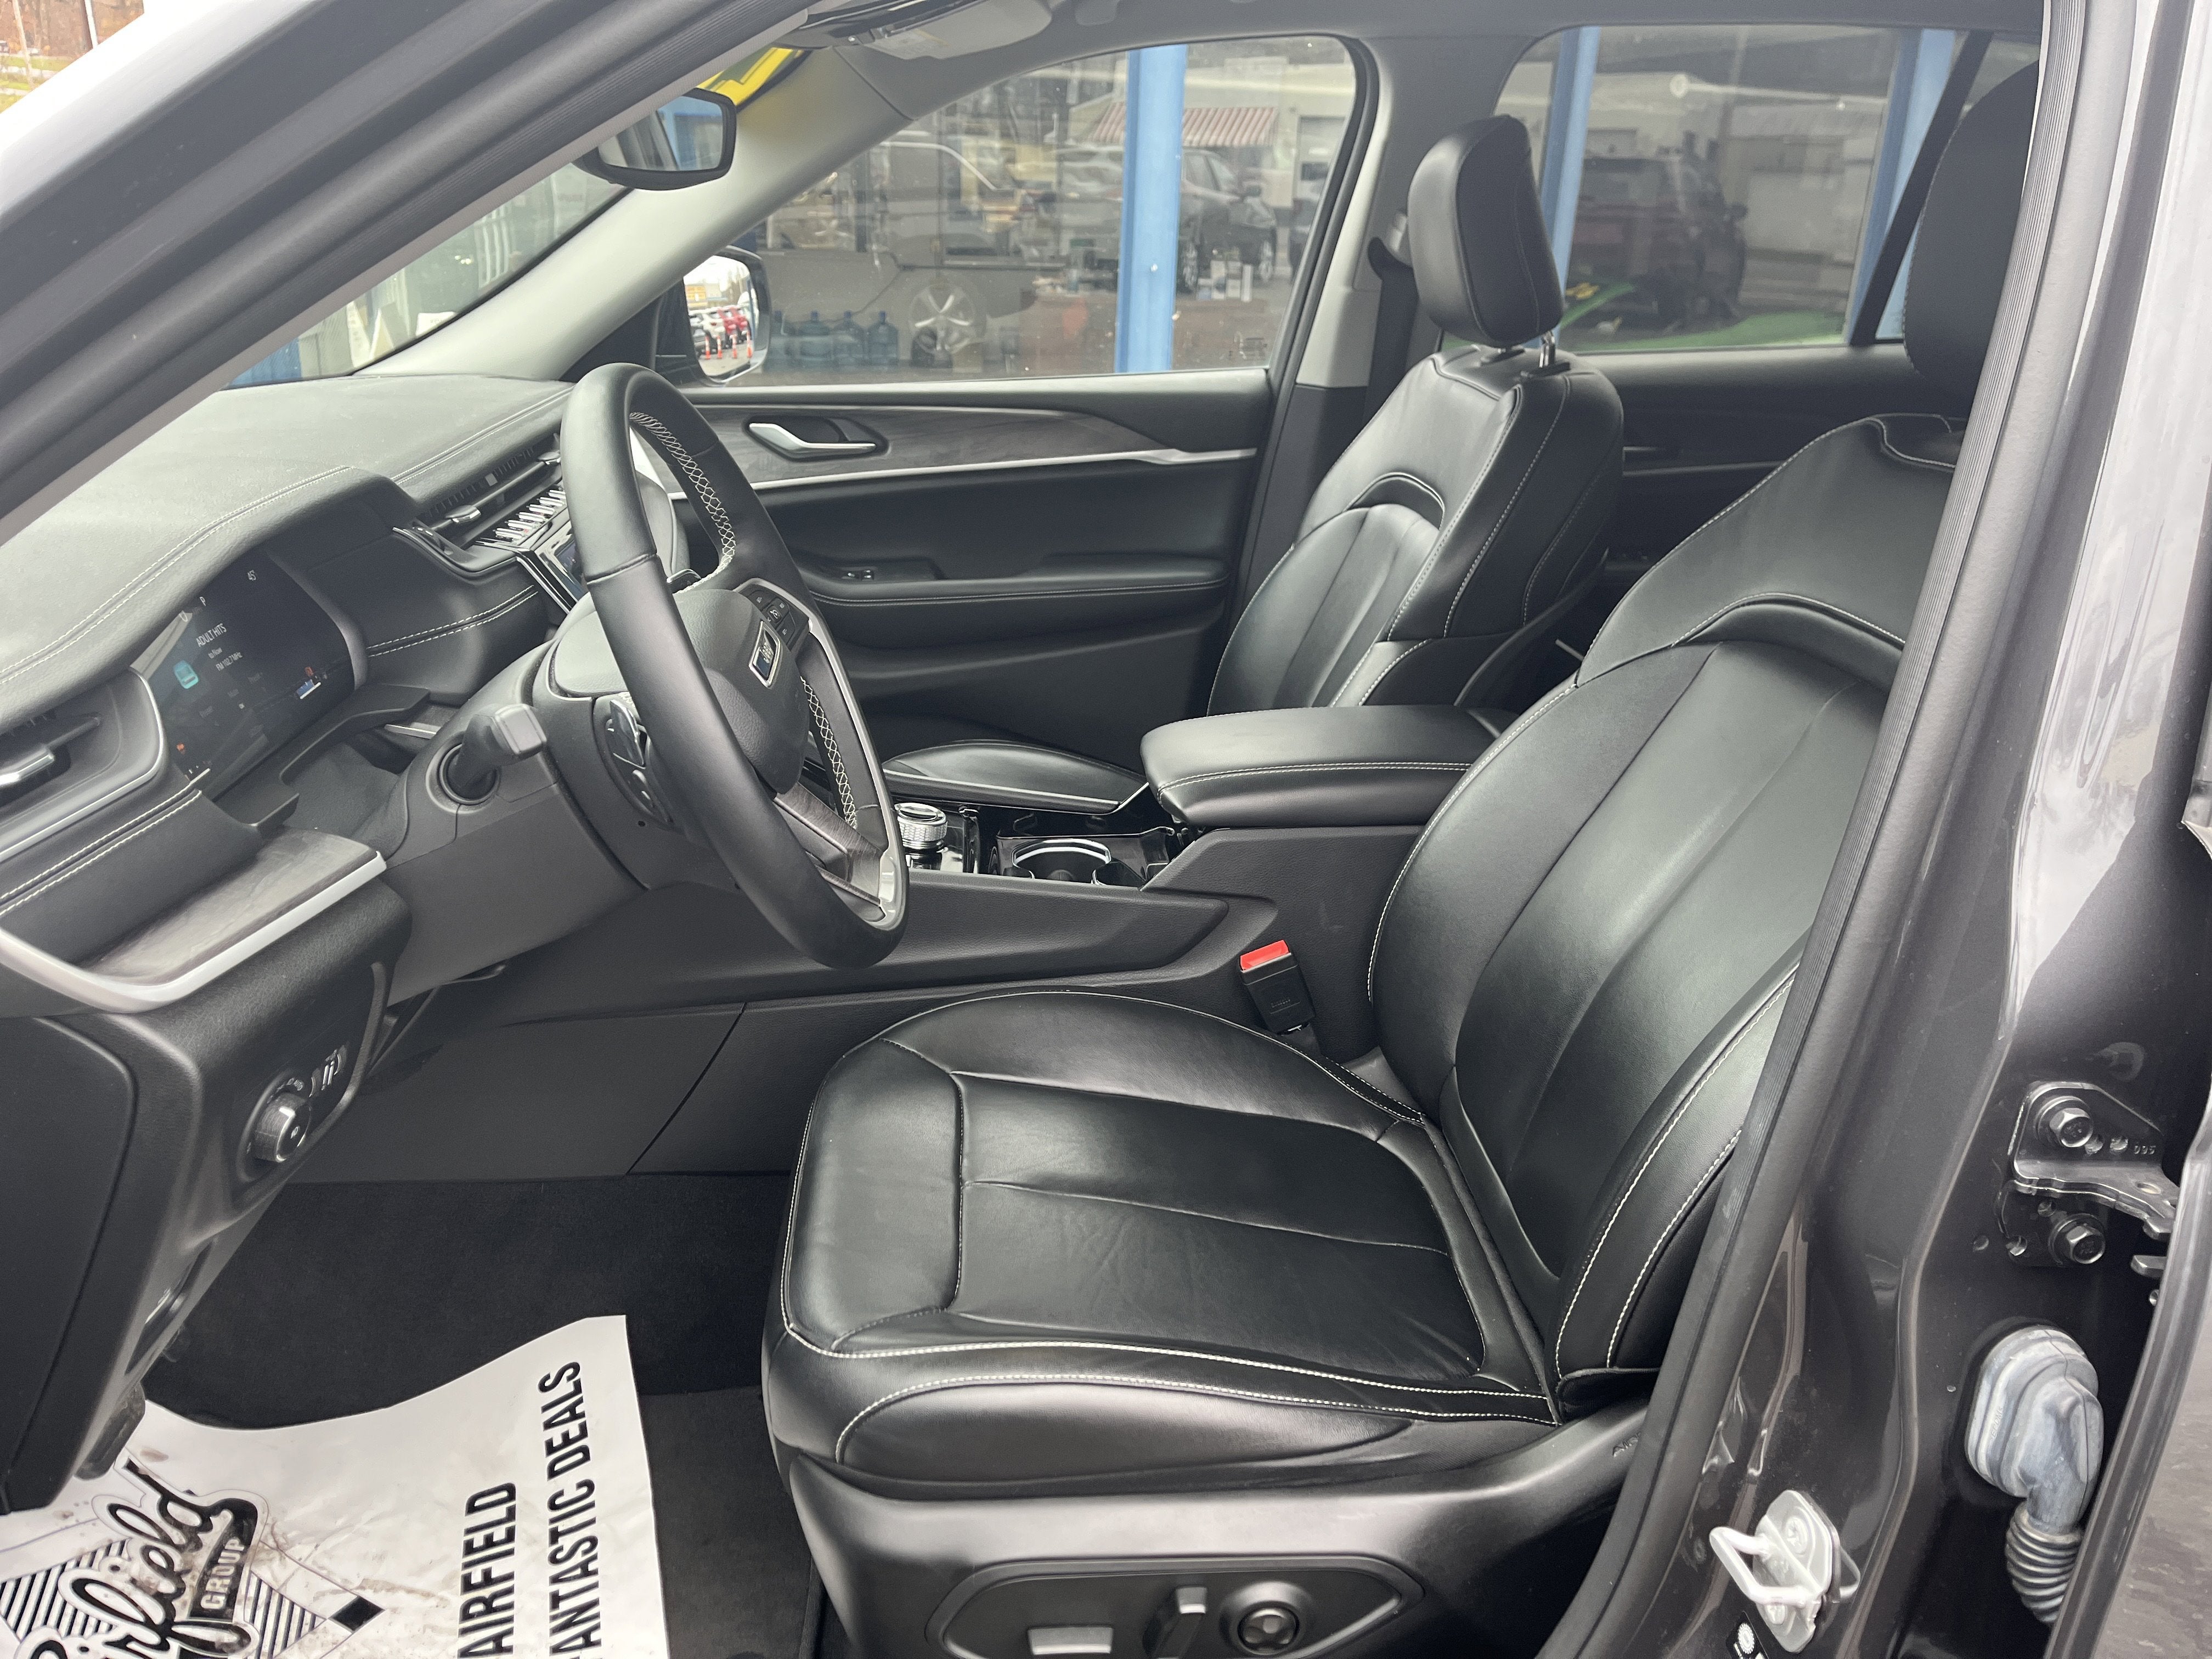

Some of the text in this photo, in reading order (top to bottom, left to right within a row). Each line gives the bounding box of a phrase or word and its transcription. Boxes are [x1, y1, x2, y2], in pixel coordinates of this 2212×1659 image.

[199, 597, 206, 606] P
[196, 623, 227, 647] ADULT HITS
[216, 651, 243, 671] FM 102.7 MHz
[294, 1080, 303, 1091] AUTO
[538, 1361, 602, 1659] ANTASTIC DEALS
[200, 1537, 246, 1610] GROUP
[457, 1482, 517, 1658] AIRFIELD
